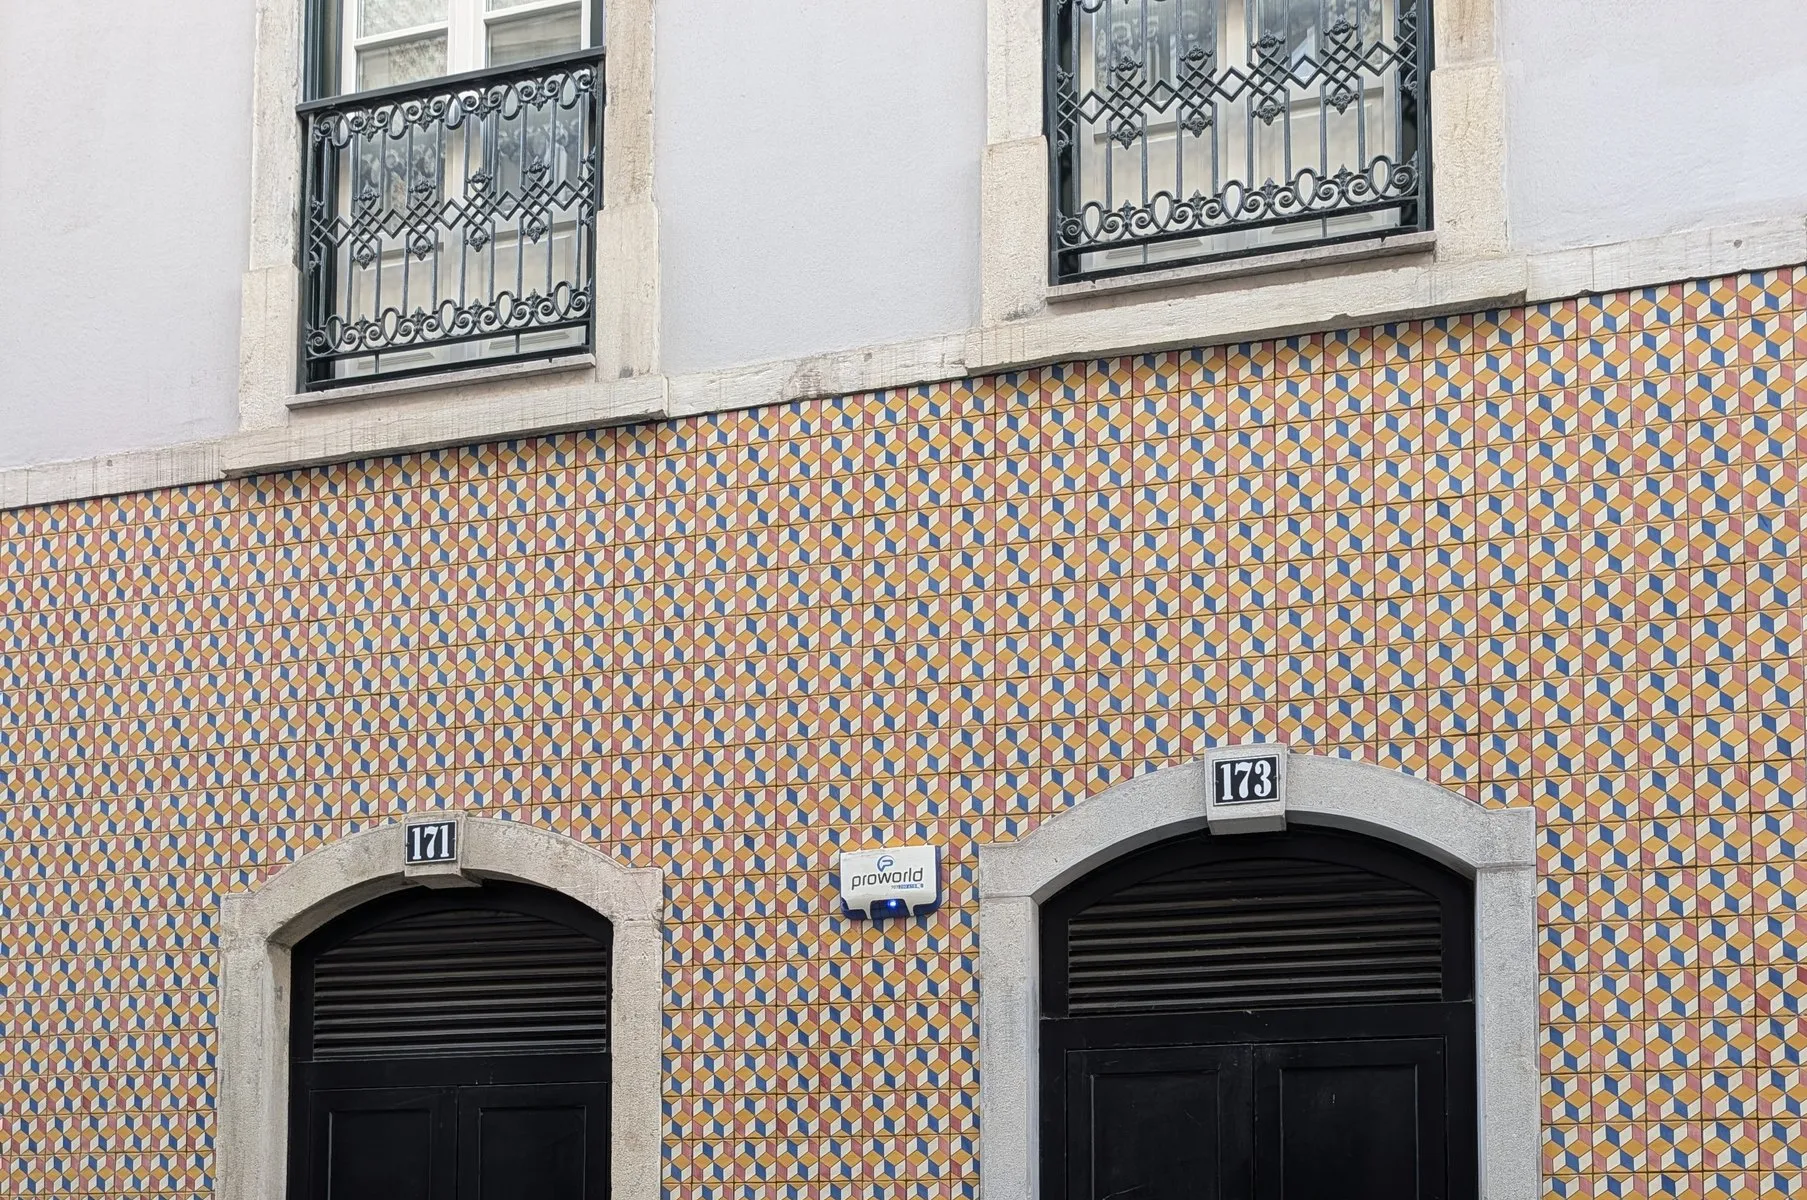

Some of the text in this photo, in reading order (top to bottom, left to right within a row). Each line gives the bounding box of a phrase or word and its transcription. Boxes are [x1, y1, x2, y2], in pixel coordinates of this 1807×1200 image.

[1220, 759, 1272, 799] 173
[412, 824, 450, 860] 171
[852, 867, 924, 891] proworld
